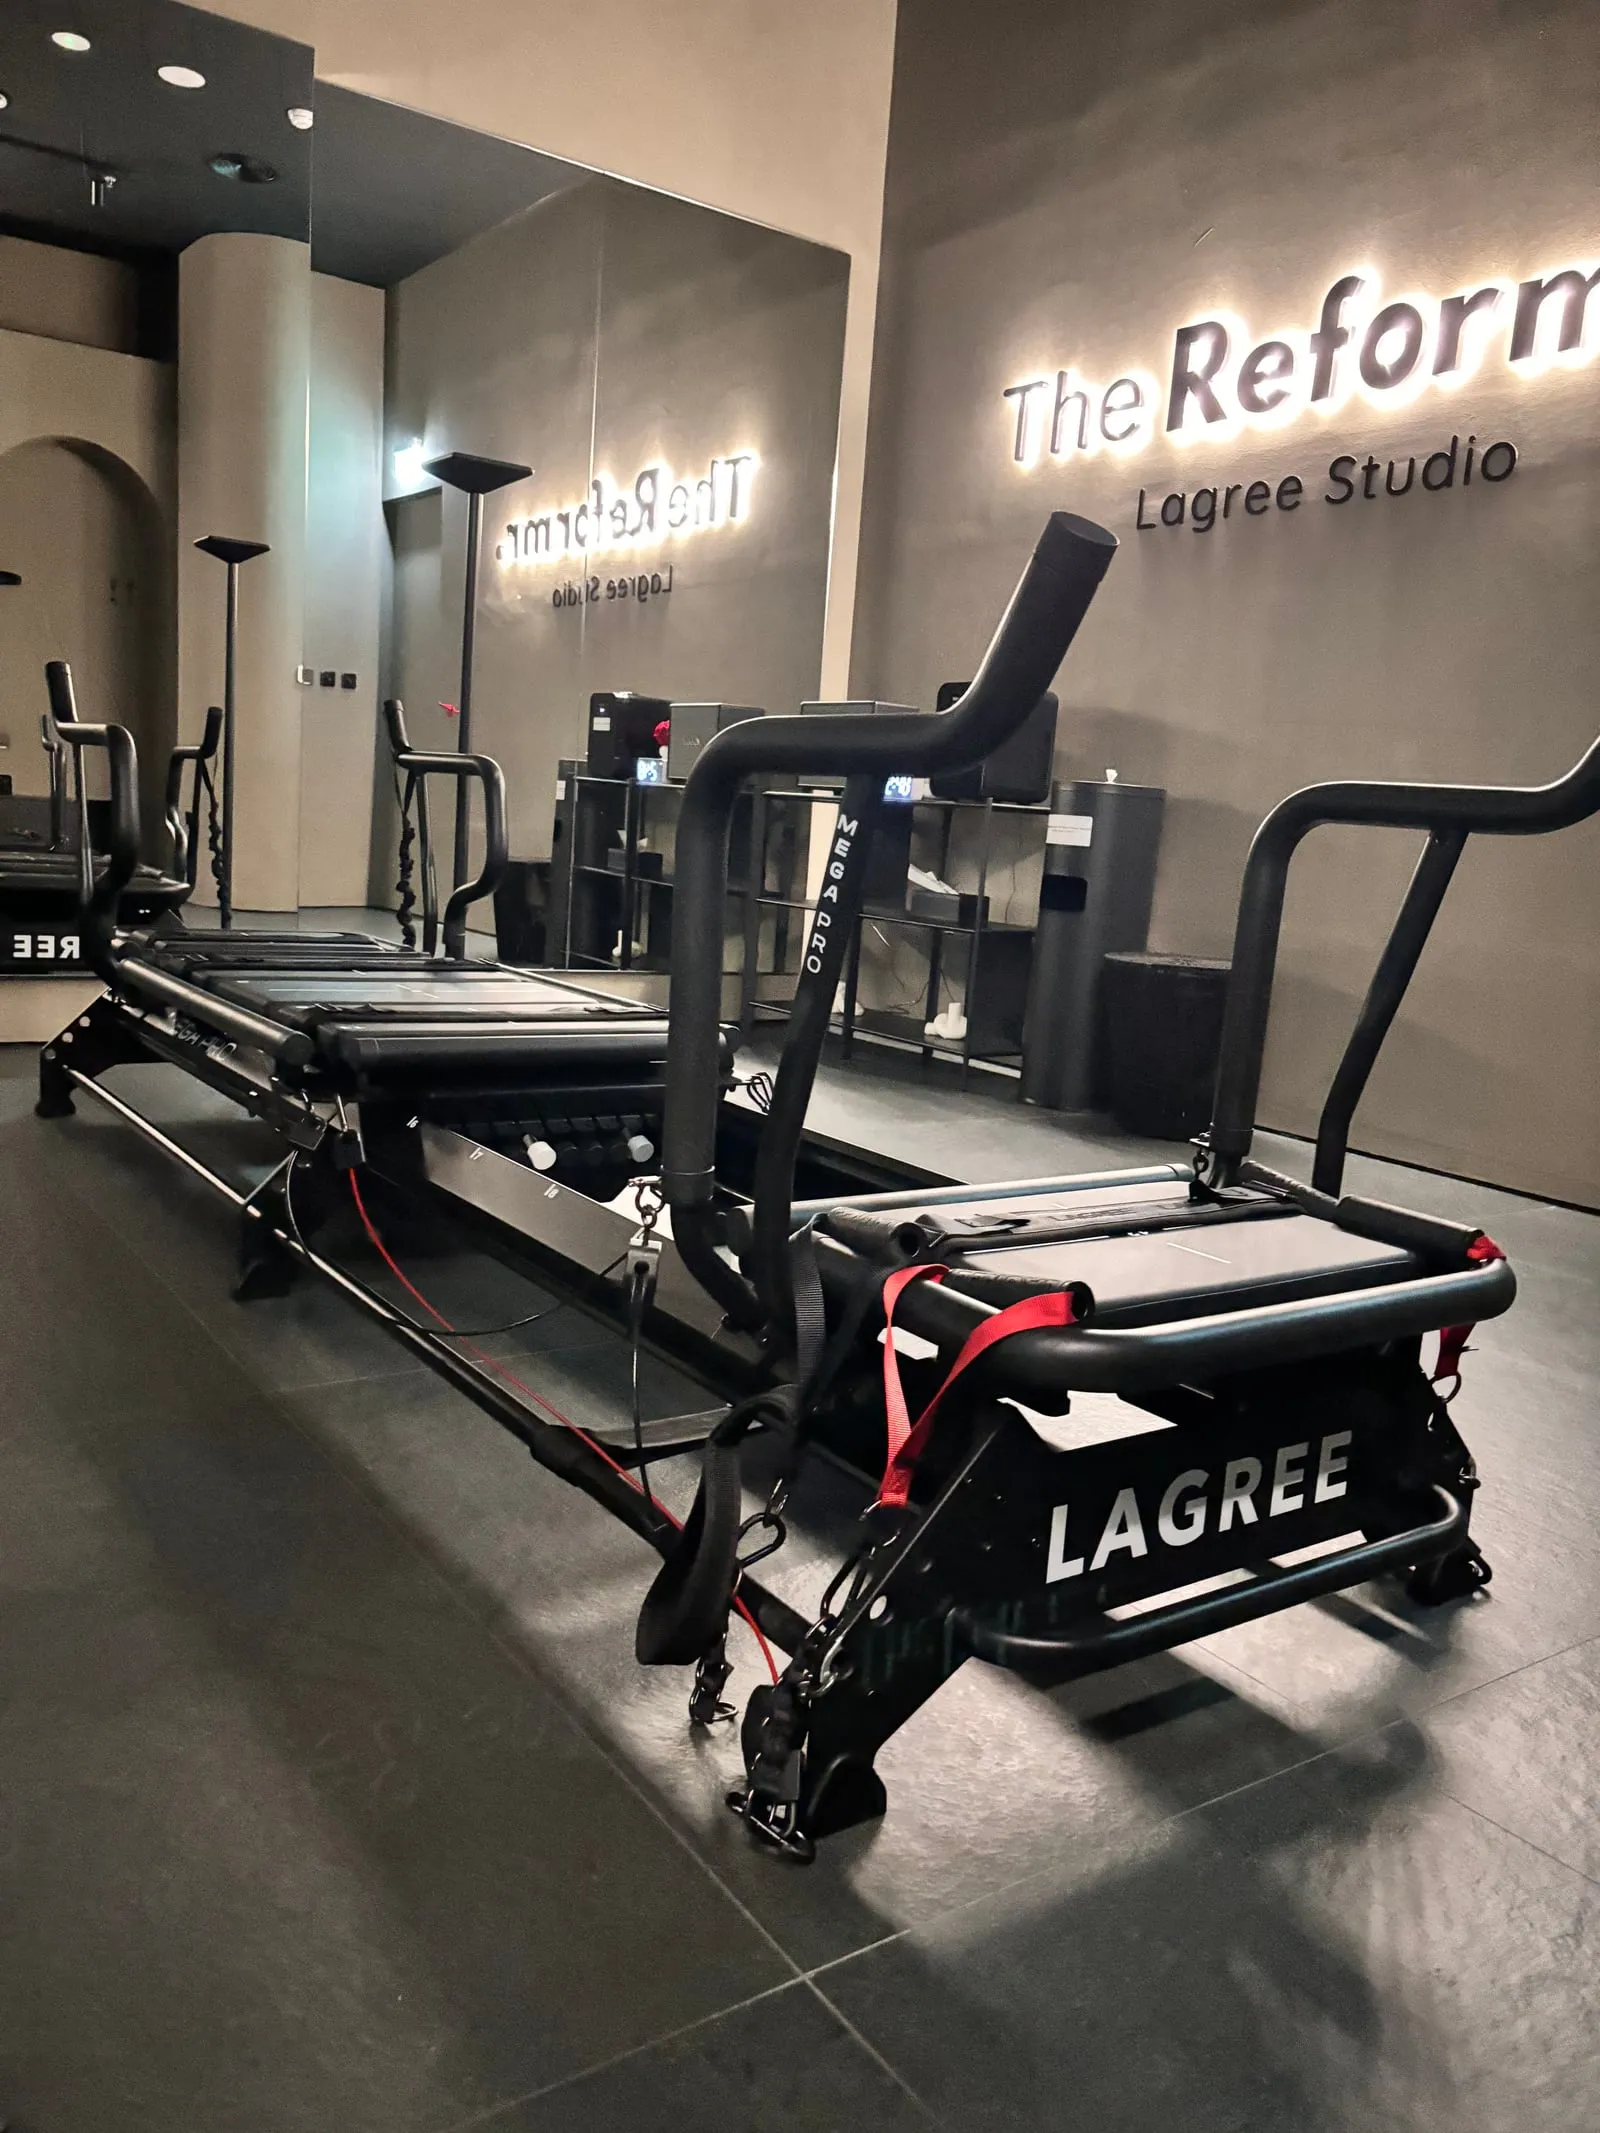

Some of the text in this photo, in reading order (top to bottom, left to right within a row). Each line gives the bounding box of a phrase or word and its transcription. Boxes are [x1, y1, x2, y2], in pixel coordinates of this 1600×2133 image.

[1003, 370, 1145, 463] The
[1136, 434, 1518, 534] Lagree Studio
[806, 814, 859, 974] MEGA PRO
[1046, 1430, 1353, 1584] LAGREE
